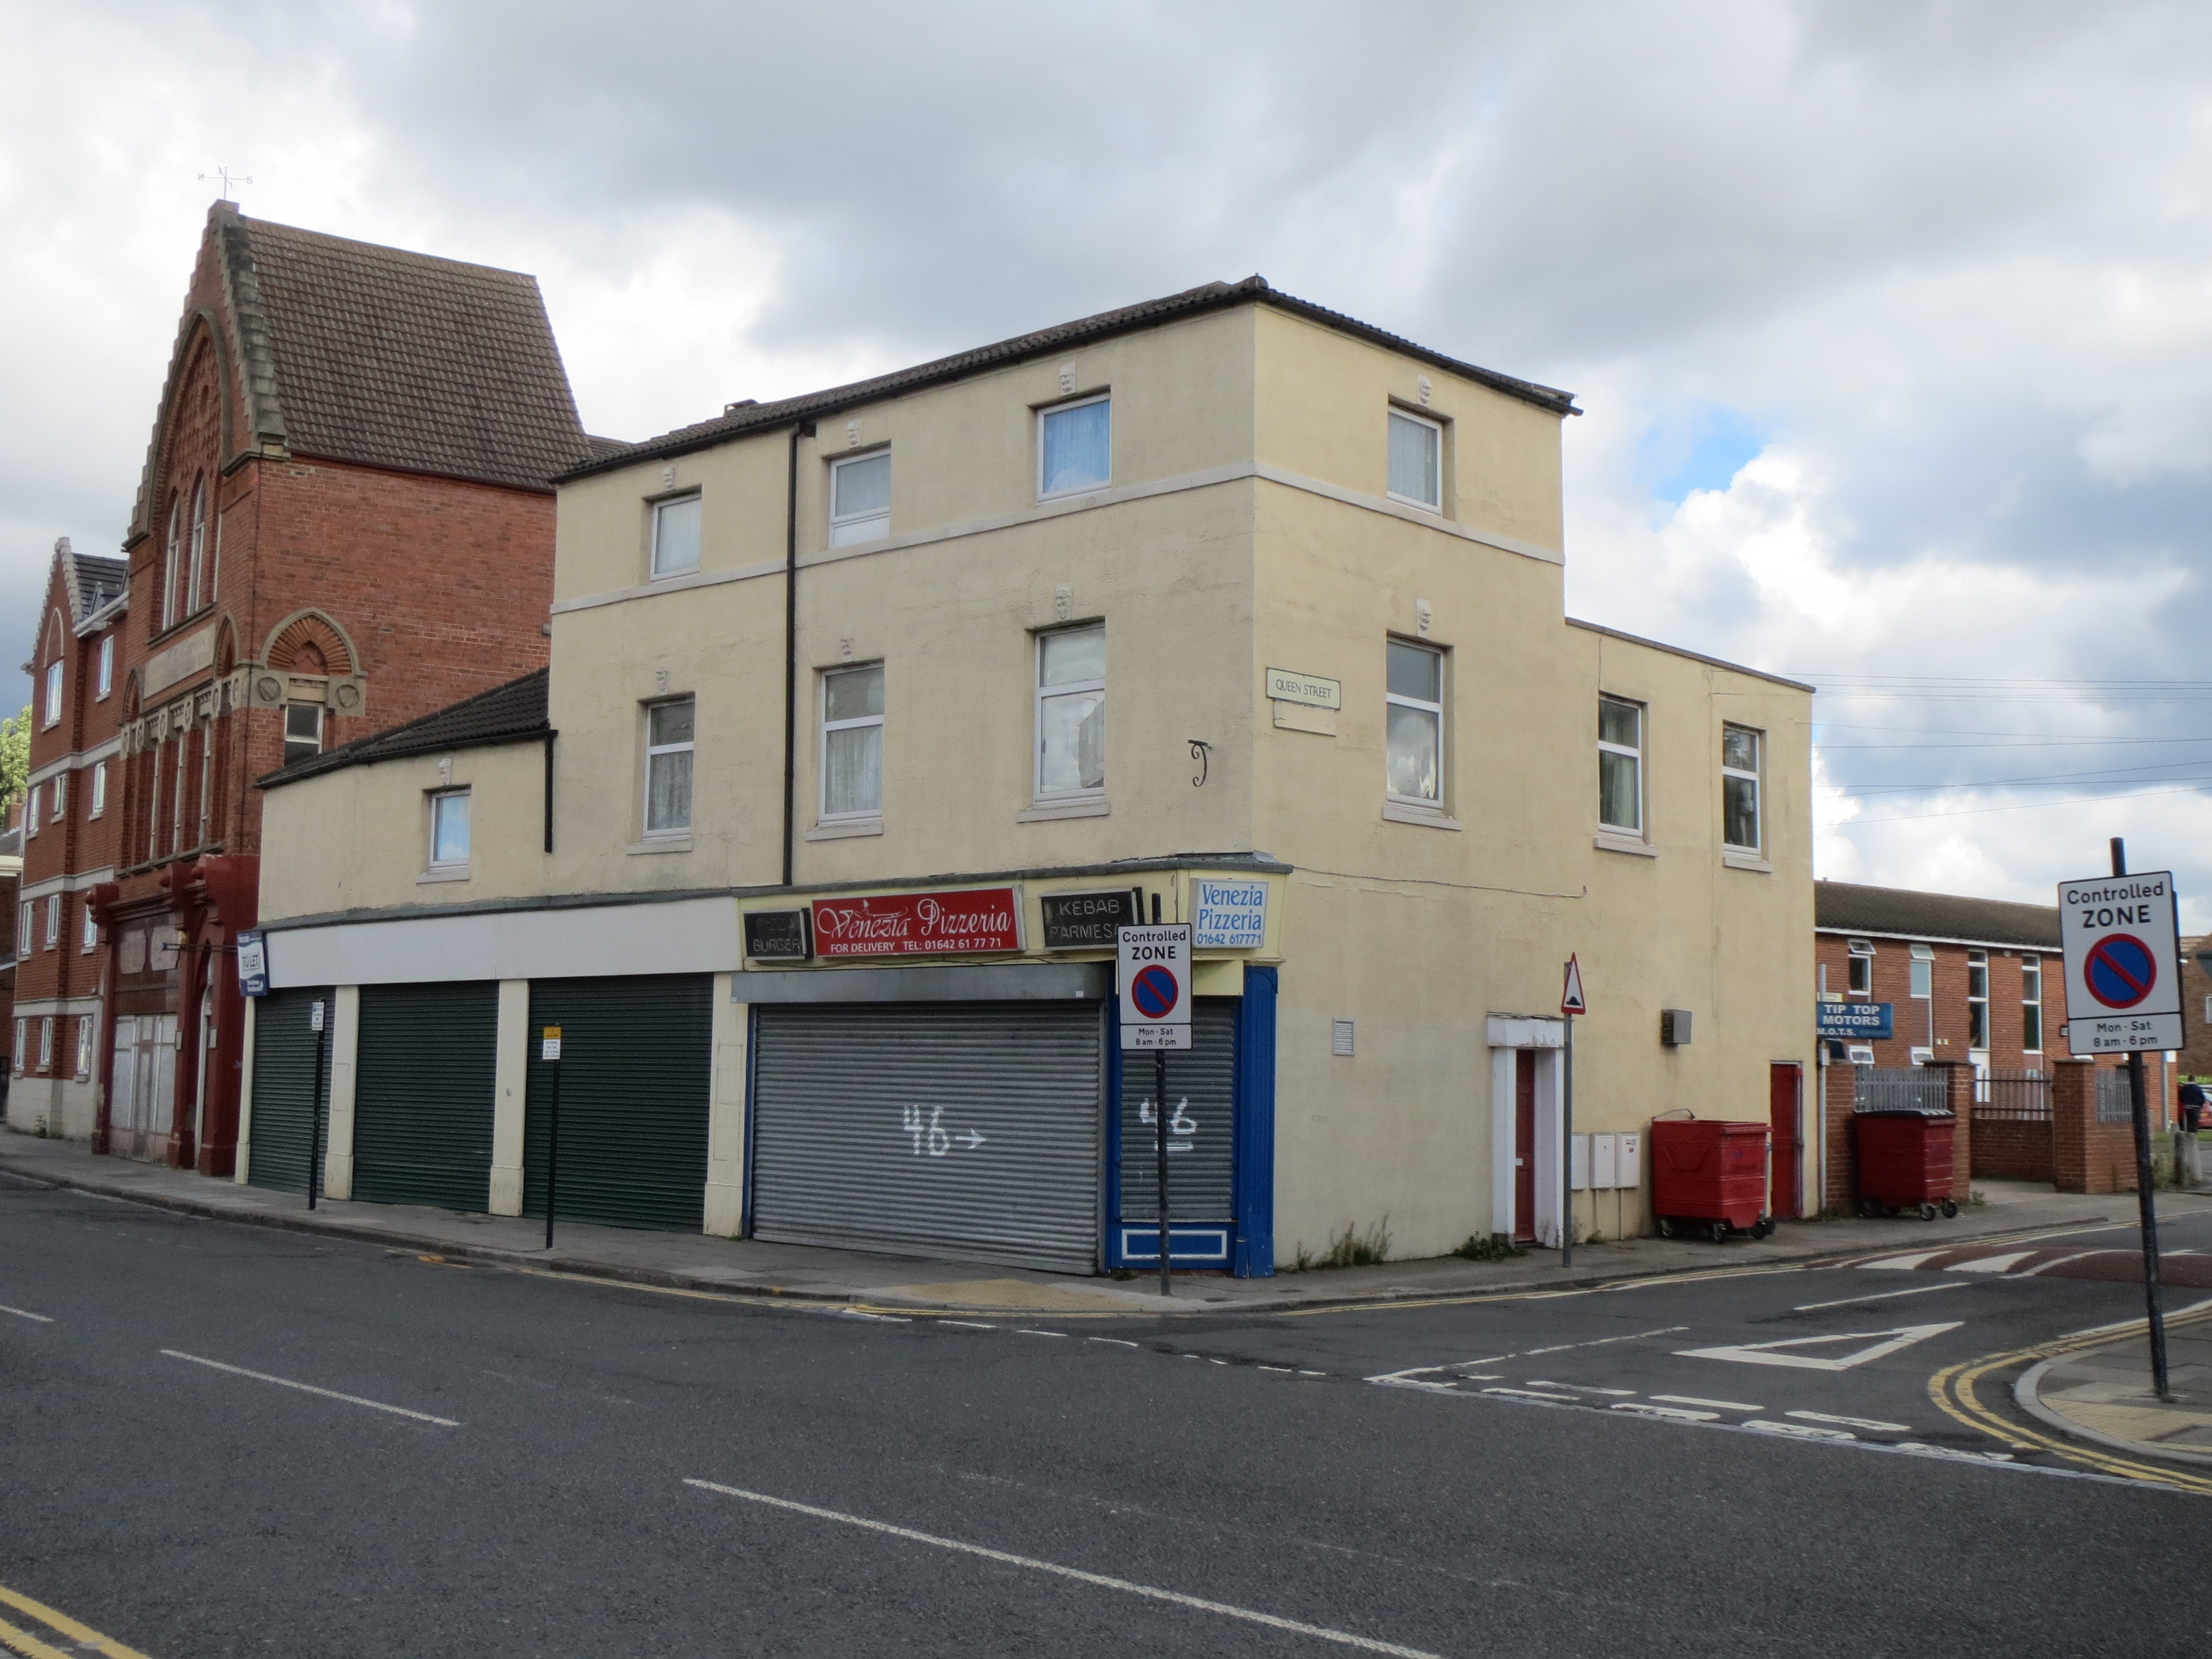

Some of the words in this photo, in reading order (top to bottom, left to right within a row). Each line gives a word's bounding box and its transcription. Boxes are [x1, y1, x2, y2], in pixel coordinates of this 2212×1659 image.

[1276, 679, 1301, 693] QUEEN
[1304, 684, 1332, 699] STREET
[1202, 885, 1262, 906] Venezia
[2067, 881, 2163, 905] Controlled
[1059, 899, 1119, 916] KEBAB
[818, 908, 911, 938] Venezia
[918, 899, 1011, 936] Pizzeria
[1198, 908, 1261, 930] Pizzeria
[2082, 905, 2151, 928] ZONE
[1050, 923, 1119, 939] PARMES
[1122, 930, 1186, 942] Controlled
[1197, 933, 1225, 944] 01642
[1229, 934, 1261, 944] 617771
[831, 943, 849, 953] FOR
[851, 942, 895, 953] DELIVERY
[903, 942, 922, 950] TEL:
[925, 940, 954, 950] 01642
[959, 939, 970, 948] 61
[974, 938, 986, 948] 77
[990, 937, 1001, 947] 71
[1131, 946, 1176, 960] ZONE
[1824, 1005, 1846, 1014] TIP
[1852, 1005, 1880, 1014] TOP
[1823, 1015, 1880, 1025] MOTORS
[2097, 1023, 2122, 1033] Mon
[2131, 1021, 2153, 1030] Sat
[2094, 1037, 2100, 1047] 8
[2103, 1038, 2120, 1047] am
[2130, 1036, 2137, 1045] 6
[2140, 1036, 2158, 1047] pm
